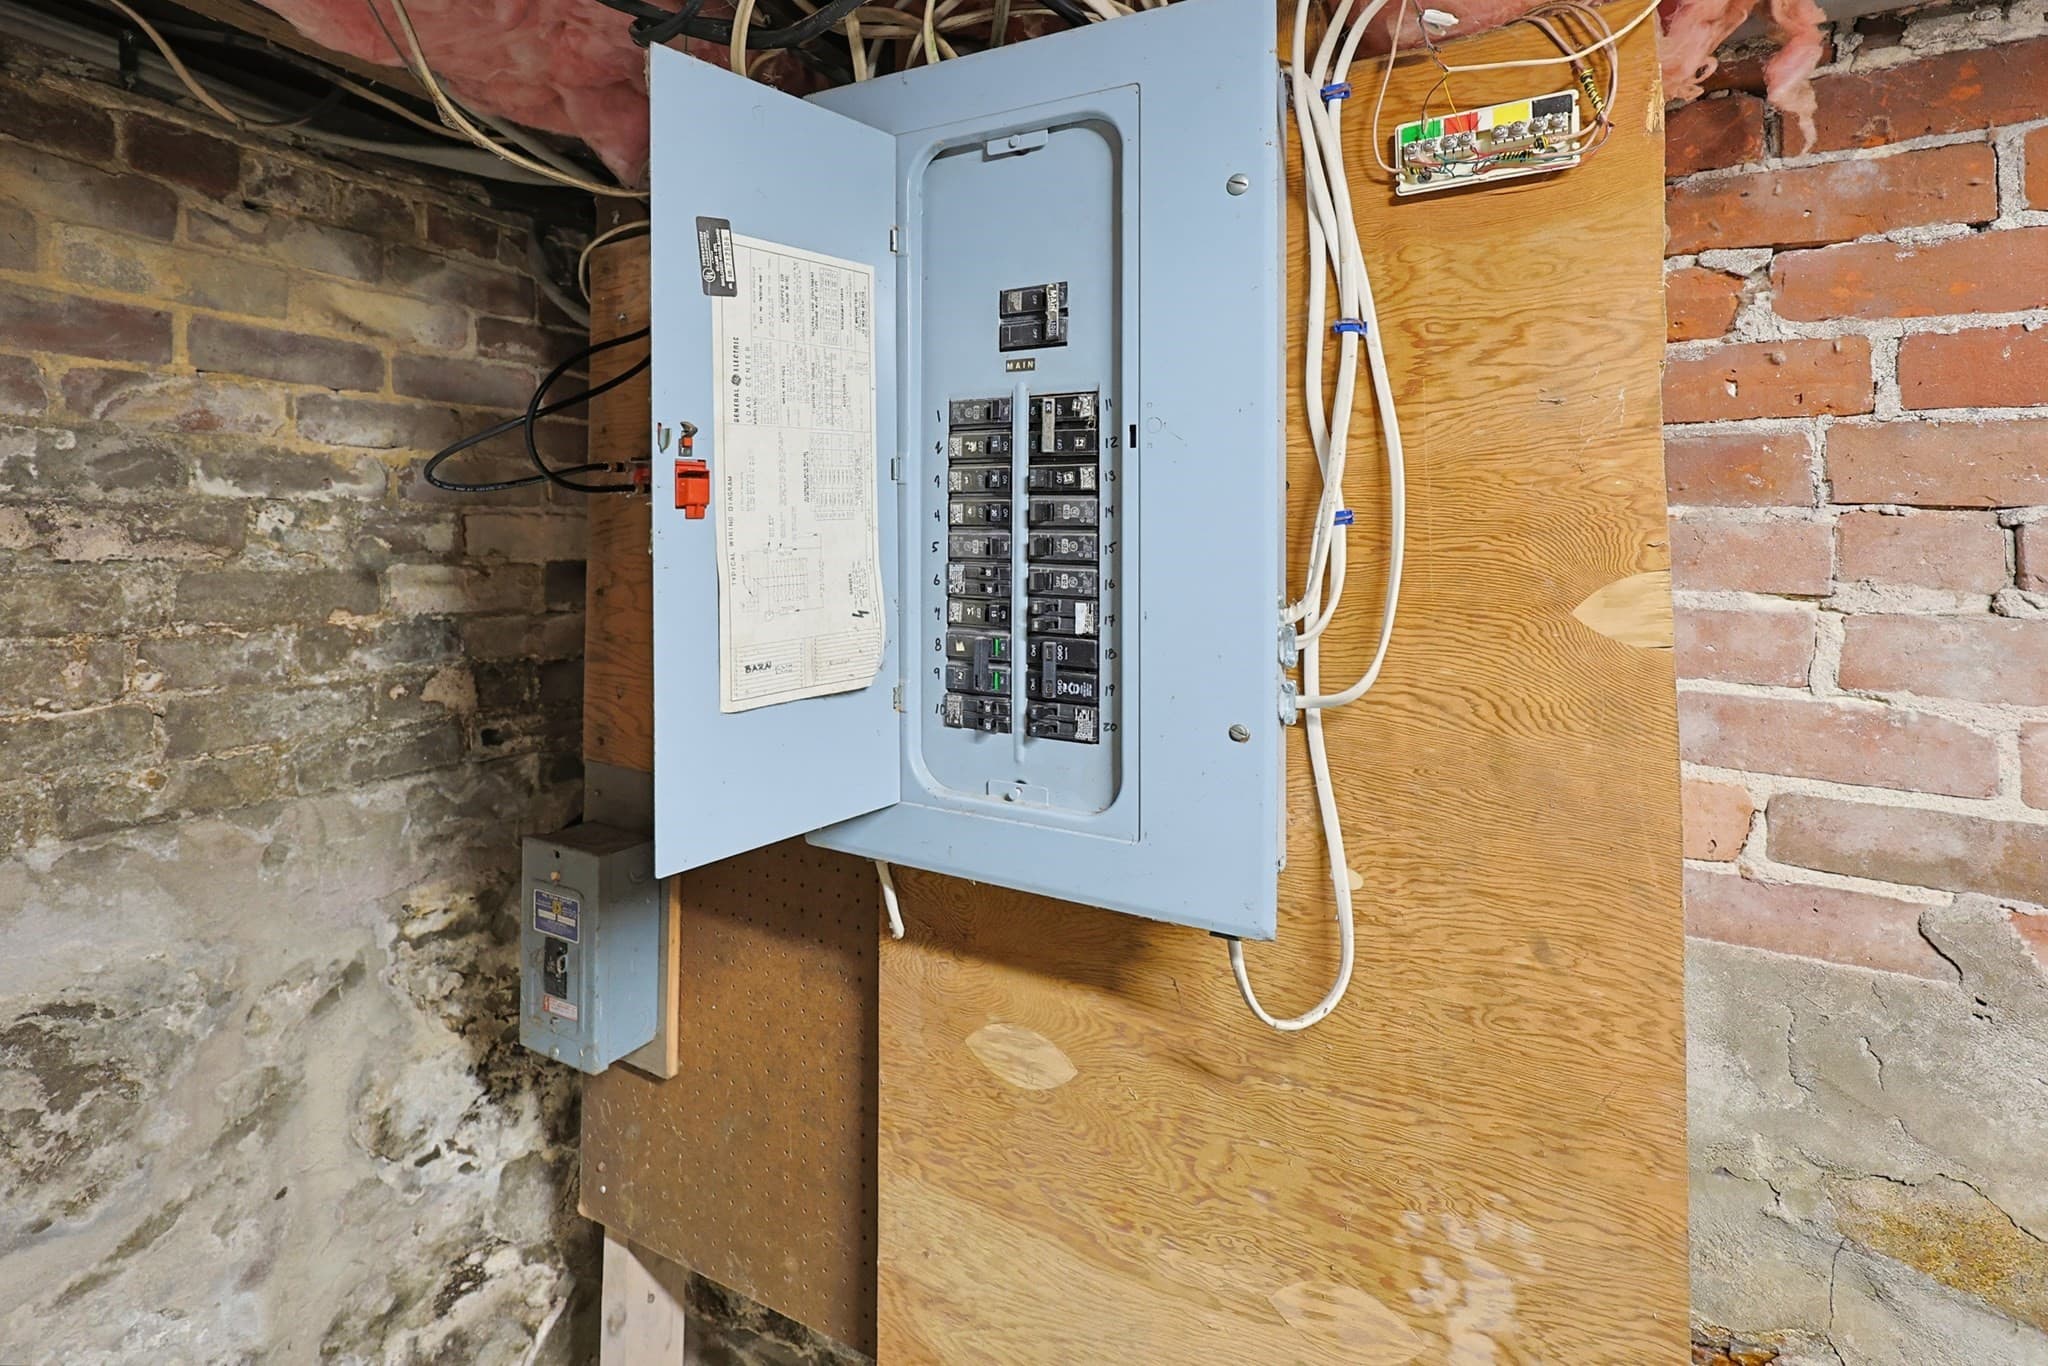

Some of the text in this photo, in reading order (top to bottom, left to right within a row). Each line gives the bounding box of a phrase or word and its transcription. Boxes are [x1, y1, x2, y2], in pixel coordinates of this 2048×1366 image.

[1006, 360, 1034, 370] MAIN
[732, 388, 740, 424] GENERAL
[1104, 398, 1112, 412] 11
[1105, 436, 1118, 449] 12
[1104, 472, 1116, 482] 13
[934, 508, 941, 522] 4
[1104, 506, 1114, 519] 14
[931, 541, 940, 553] 5
[1104, 542, 1117, 555] 15
[933, 574, 940, 586] 6
[1104, 579, 1116, 591] 16
[1104, 614, 1116, 626] 17
[934, 638, 942, 652] 8
[1105, 649, 1117, 660] 18
[934, 667, 940, 680] 9
[1104, 684, 1116, 697] 19
[935, 704, 946, 715] 10
[1103, 722, 1118, 732] 20
